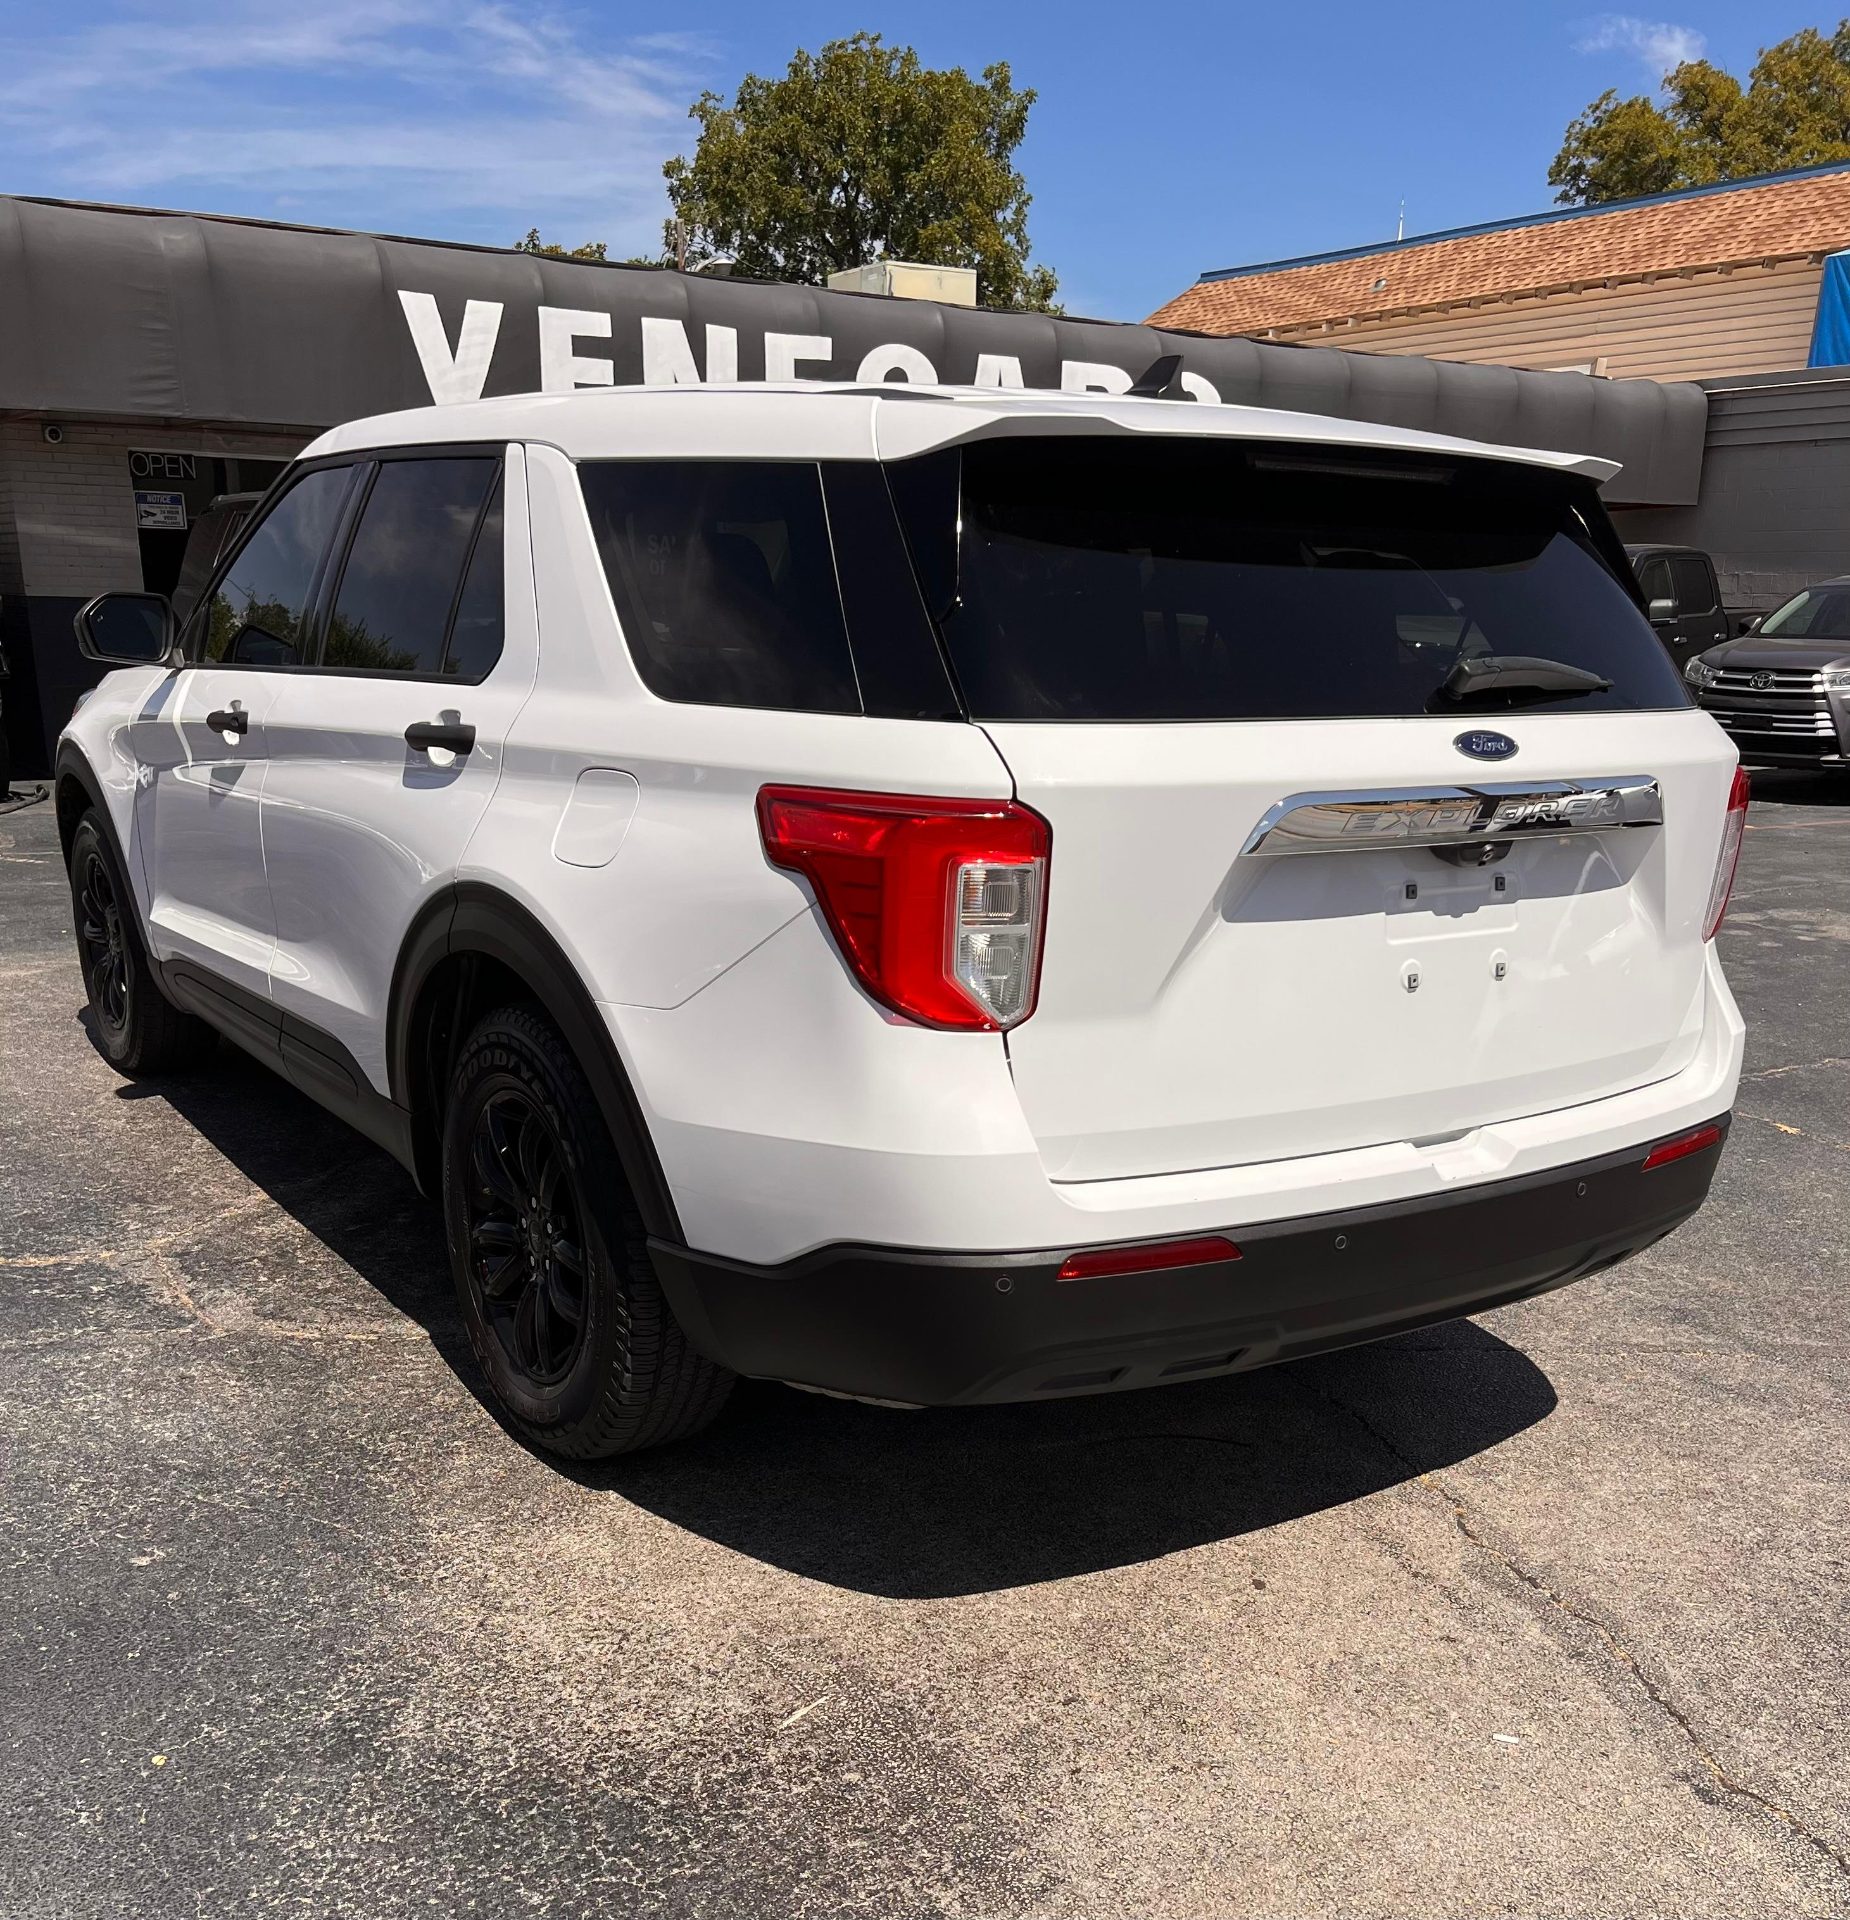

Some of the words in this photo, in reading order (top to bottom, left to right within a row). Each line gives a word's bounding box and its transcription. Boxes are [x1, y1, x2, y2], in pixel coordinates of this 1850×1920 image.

[130, 452, 196, 479] OPEN
[146, 494, 171, 504] NOTICE
[1472, 734, 1508, 752] Ford
[1340, 797, 1620, 834] EXPLORER
